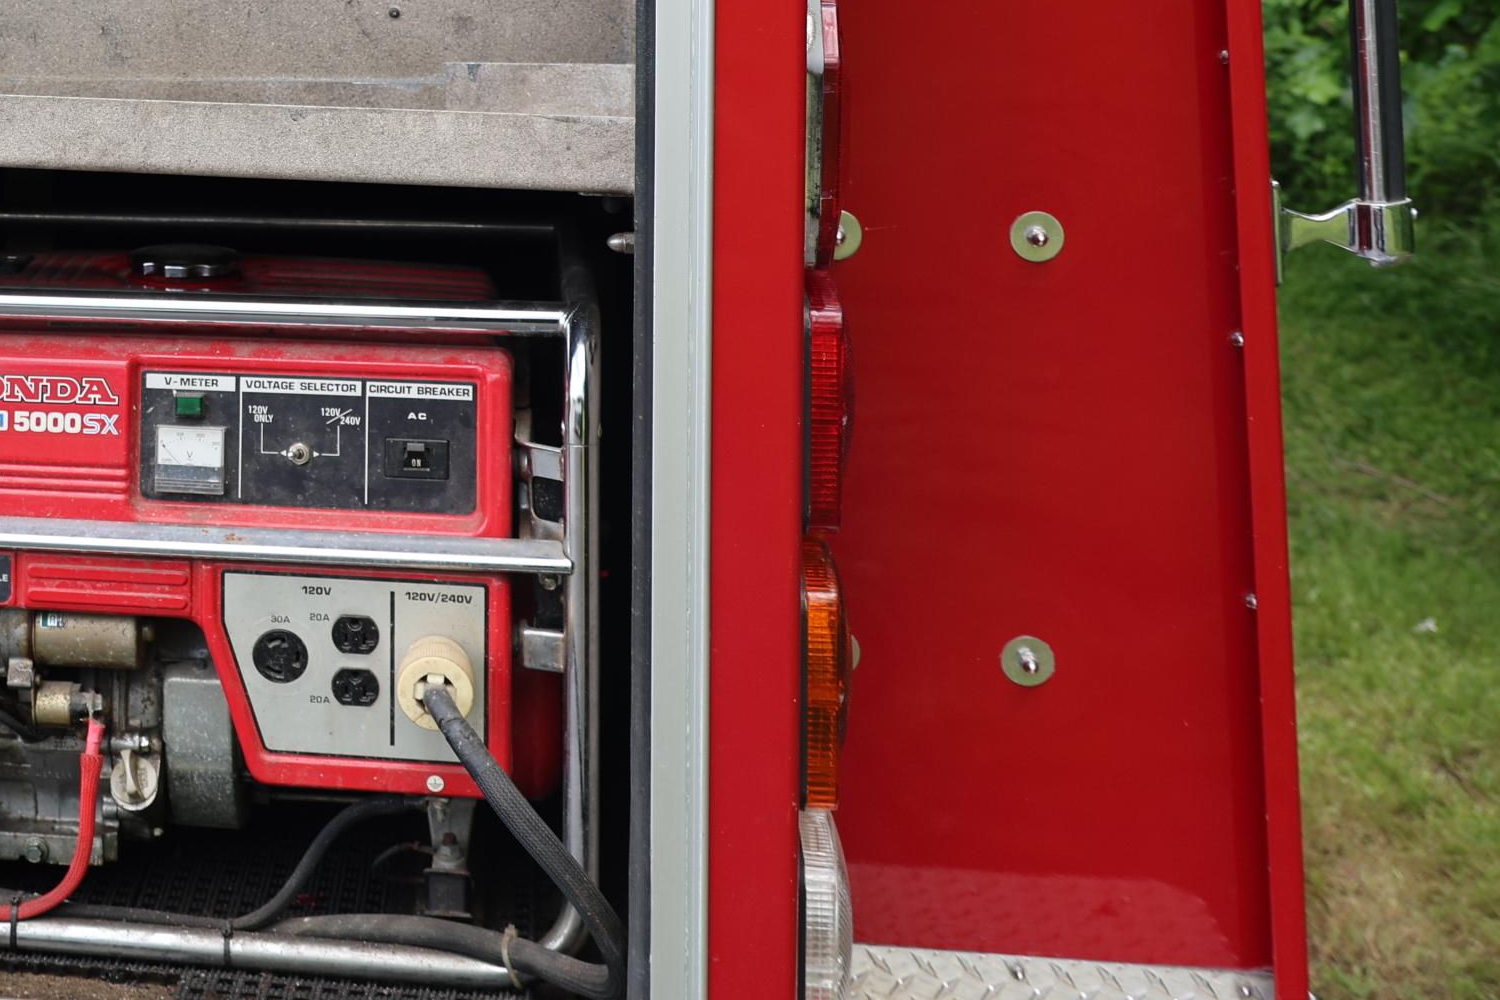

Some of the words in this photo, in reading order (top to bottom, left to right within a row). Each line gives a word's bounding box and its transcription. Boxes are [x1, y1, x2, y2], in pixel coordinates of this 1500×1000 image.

[164, 377, 219, 387] V-METER
[246, 380, 295, 390] VOLTAGE
[300, 382, 357, 393] SELECTOR
[369, 384, 412, 394] CIRCUIT
[417, 386, 470, 397] BREAKER
[248, 405, 268, 413] 120V
[254, 414, 274, 423] ONLY
[407, 412, 427, 420] AC
[14, 410, 119, 436] 5000SX
[411, 458, 422, 467] ON
[302, 586, 332, 596] 120V
[405, 591, 473, 604] 120V/240V
[270, 615, 290, 623] 30A
[309, 613, 330, 622] 20A
[309, 696, 331, 704] 20A
